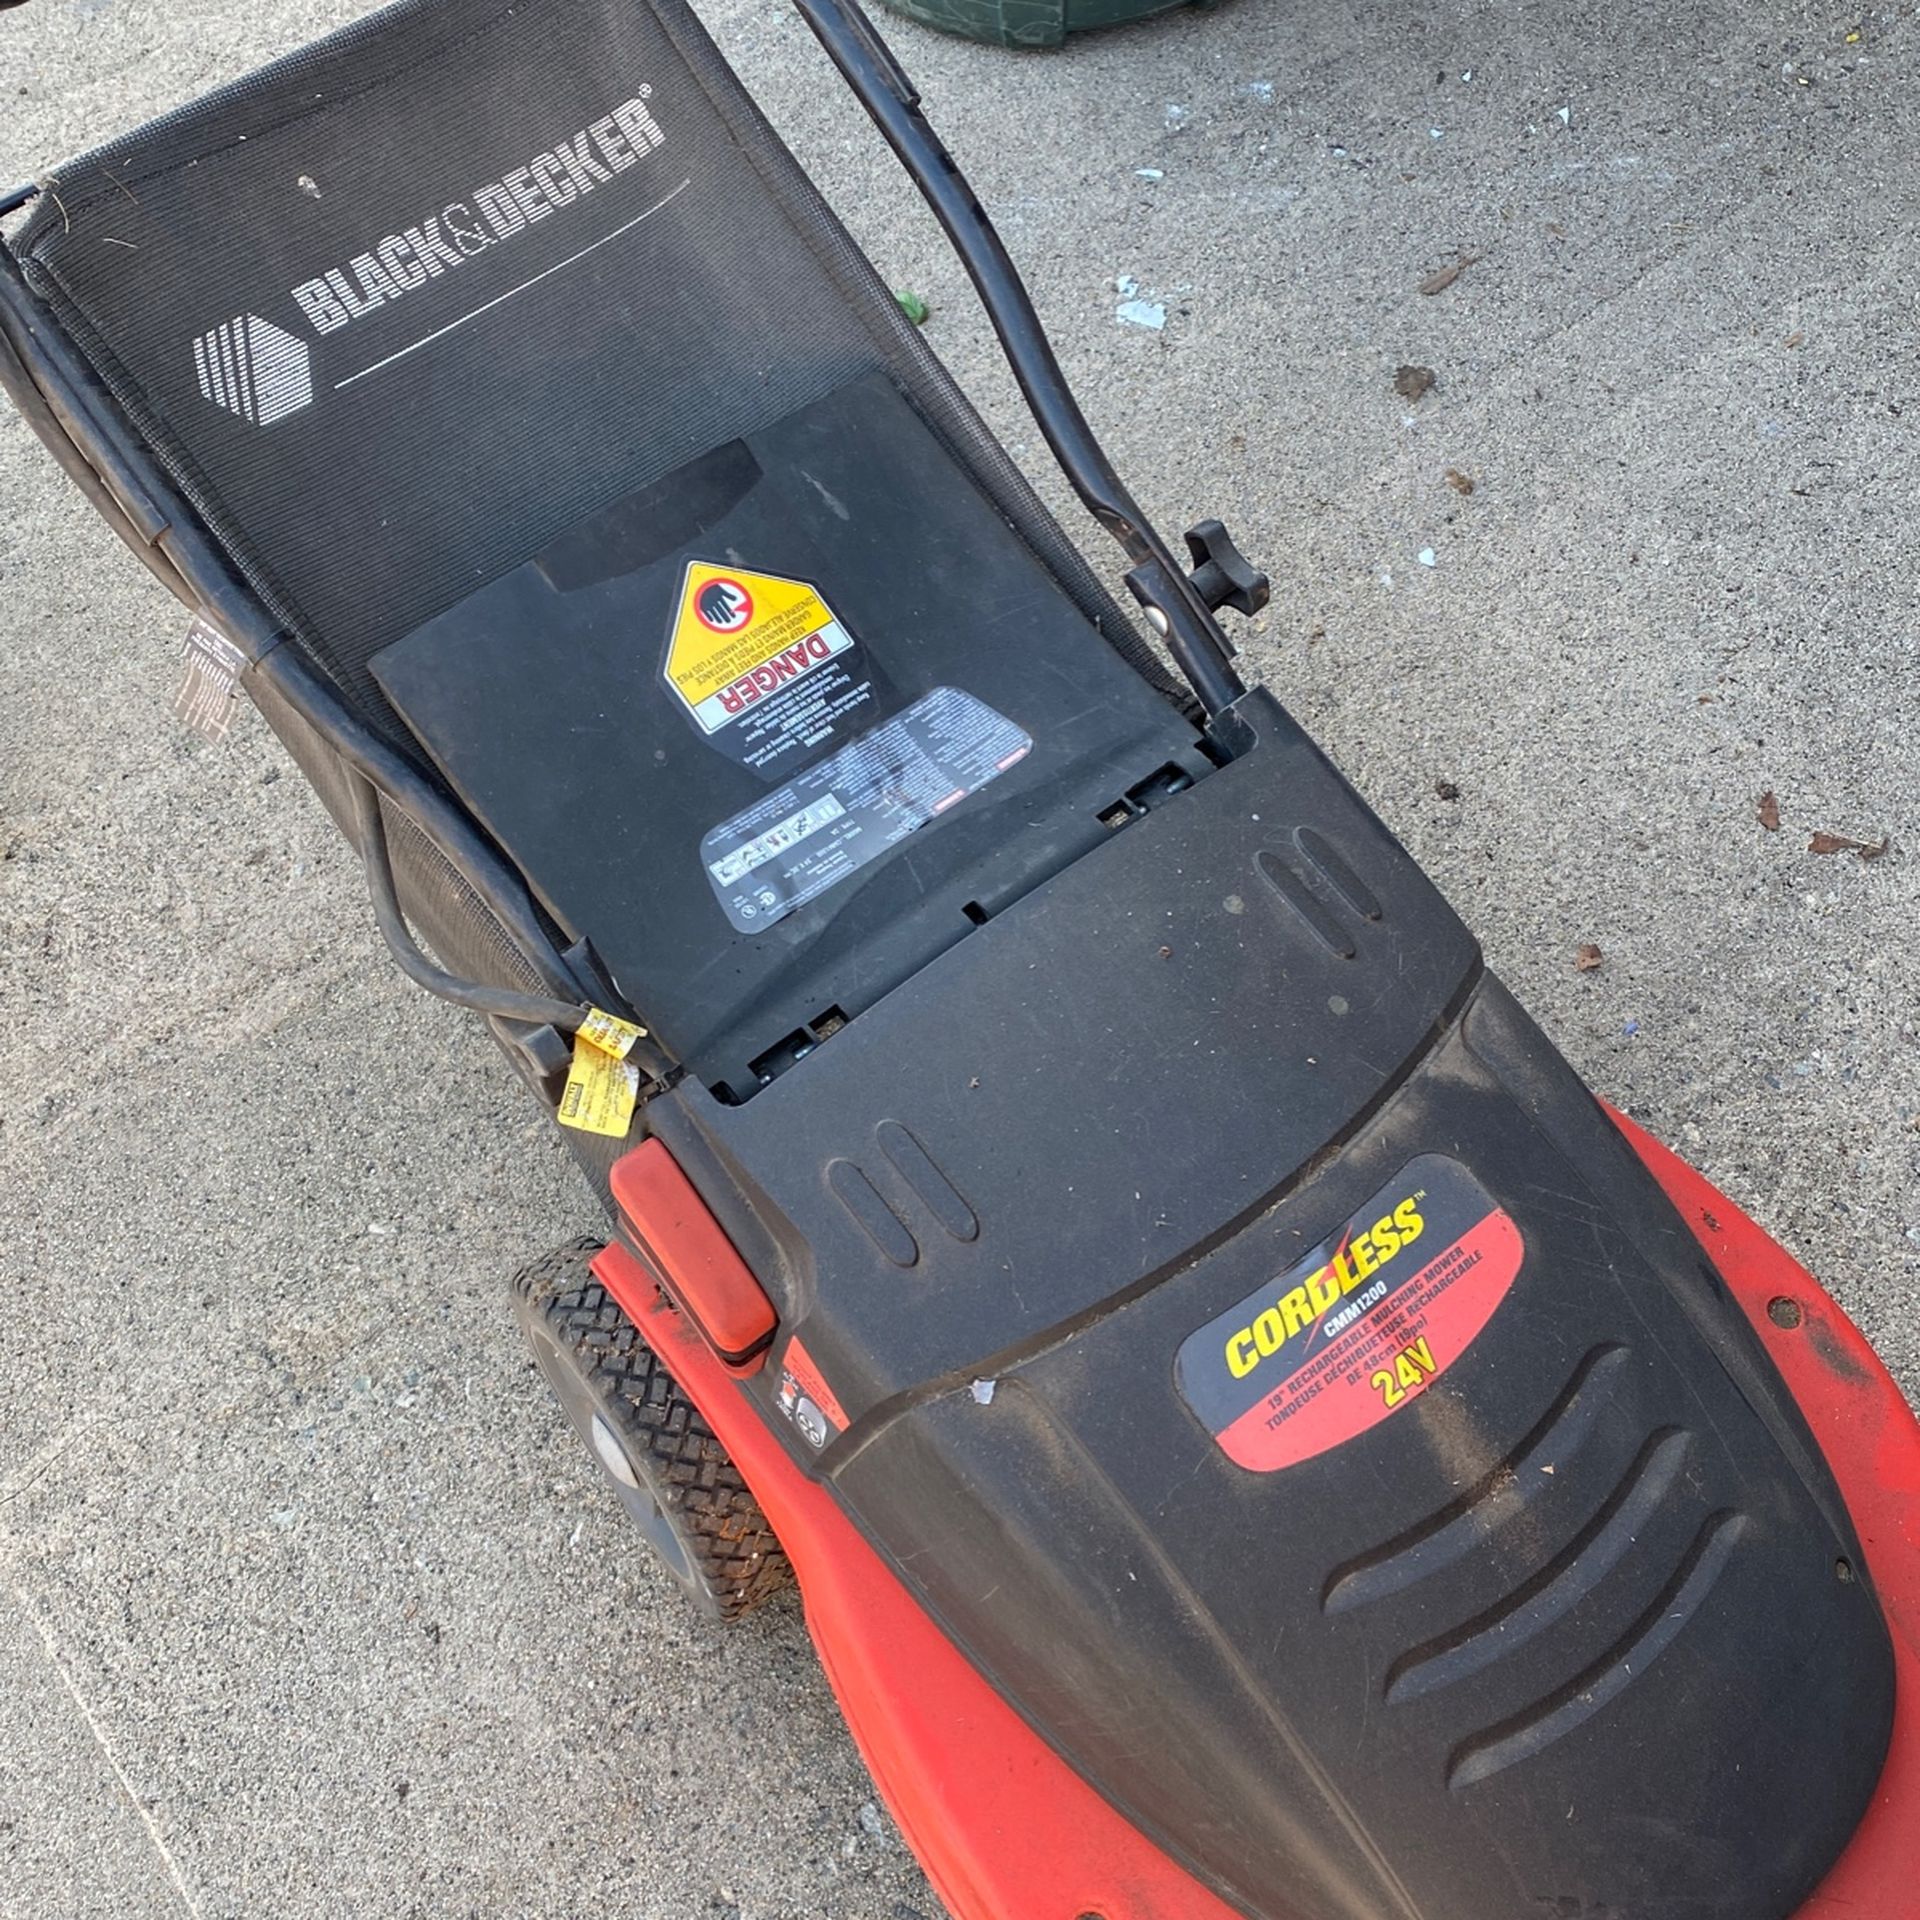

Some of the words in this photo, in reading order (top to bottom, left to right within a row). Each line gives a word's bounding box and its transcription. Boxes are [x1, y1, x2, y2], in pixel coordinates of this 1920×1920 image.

[782, 594, 816, 619] CONSERVE
[749, 614, 783, 640] ALEJADOS
[784, 609, 812, 631] GARDER
[736, 633, 752, 647] LAS
[762, 624, 787, 644] MAINS
[788, 624, 806, 640] KEEP
[710, 642, 738, 663] MANOS
[733, 643, 755, 662] PIEDS
[753, 638, 764, 649] ET
[765, 634, 790, 654] HANDS
[734, 658, 752, 673] FEET
[750, 649, 766, 663] AND
[676, 669, 693, 684] PIES
[691, 660, 707, 675] LOS
[694, 659, 730, 685] DISTANCE
[713, 668, 735, 686] AWAY
[715, 631, 831, 716] DANGER
[1225, 1198, 1425, 1379] CORDLESS
[1286, 1321, 1371, 1394] RECHARGEABLE
[1369, 1278, 1424, 1326] MULCHING
[1422, 1245, 1464, 1283] MOWER
[1323, 1281, 1388, 1338] CMM1200
[1264, 1379, 1324, 1431] TONDEUSE
[1405, 1248, 1484, 1317] RECHARGEABLE
[1345, 1367, 1363, 1386] DE
[1361, 1340, 1396, 1373] 48cm
[1393, 1313, 1430, 1348] (19po)
[1370, 1336, 1438, 1408] 24V
